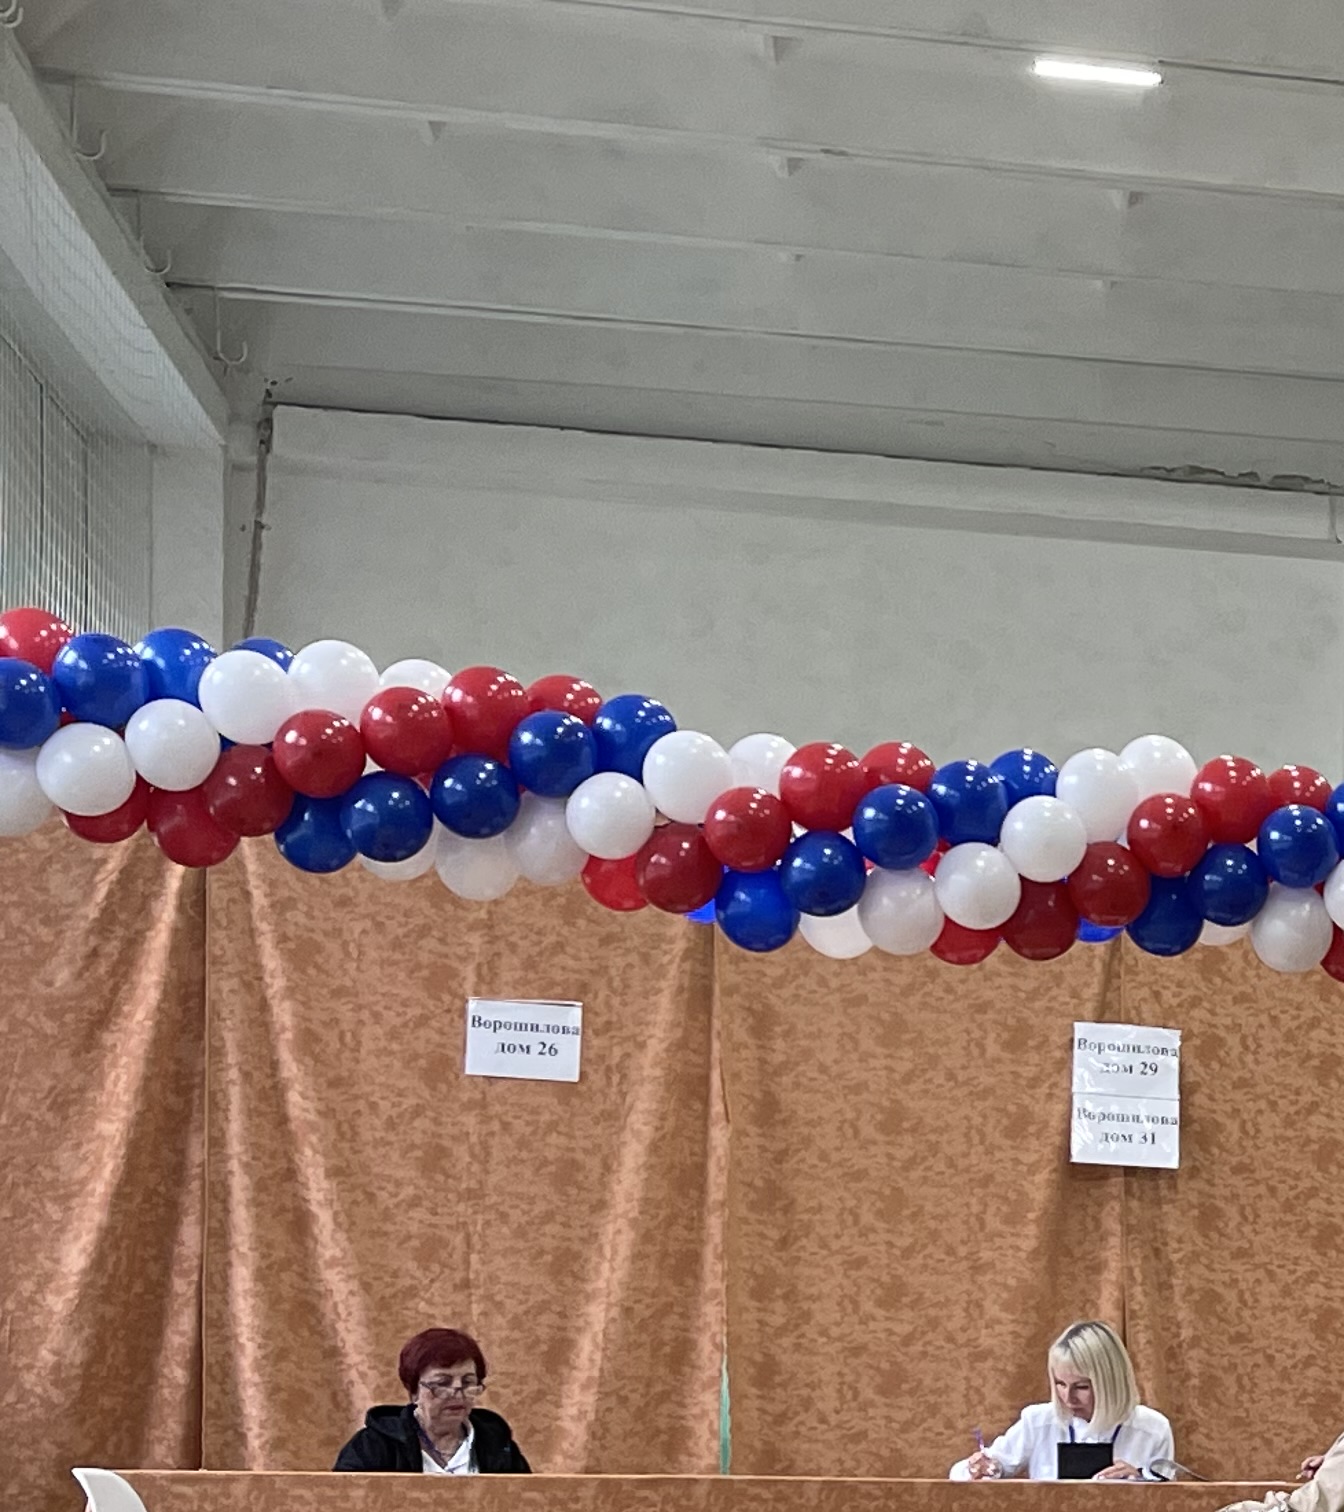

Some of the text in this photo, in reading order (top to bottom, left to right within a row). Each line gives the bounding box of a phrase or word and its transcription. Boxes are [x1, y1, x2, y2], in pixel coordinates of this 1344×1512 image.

[471, 1015, 580, 1036] Ворошилова
[494, 1041, 559, 1057] дом 26
[1139, 1061, 1158, 1076] 29
[1099, 1131, 1156, 1145] дом 31
